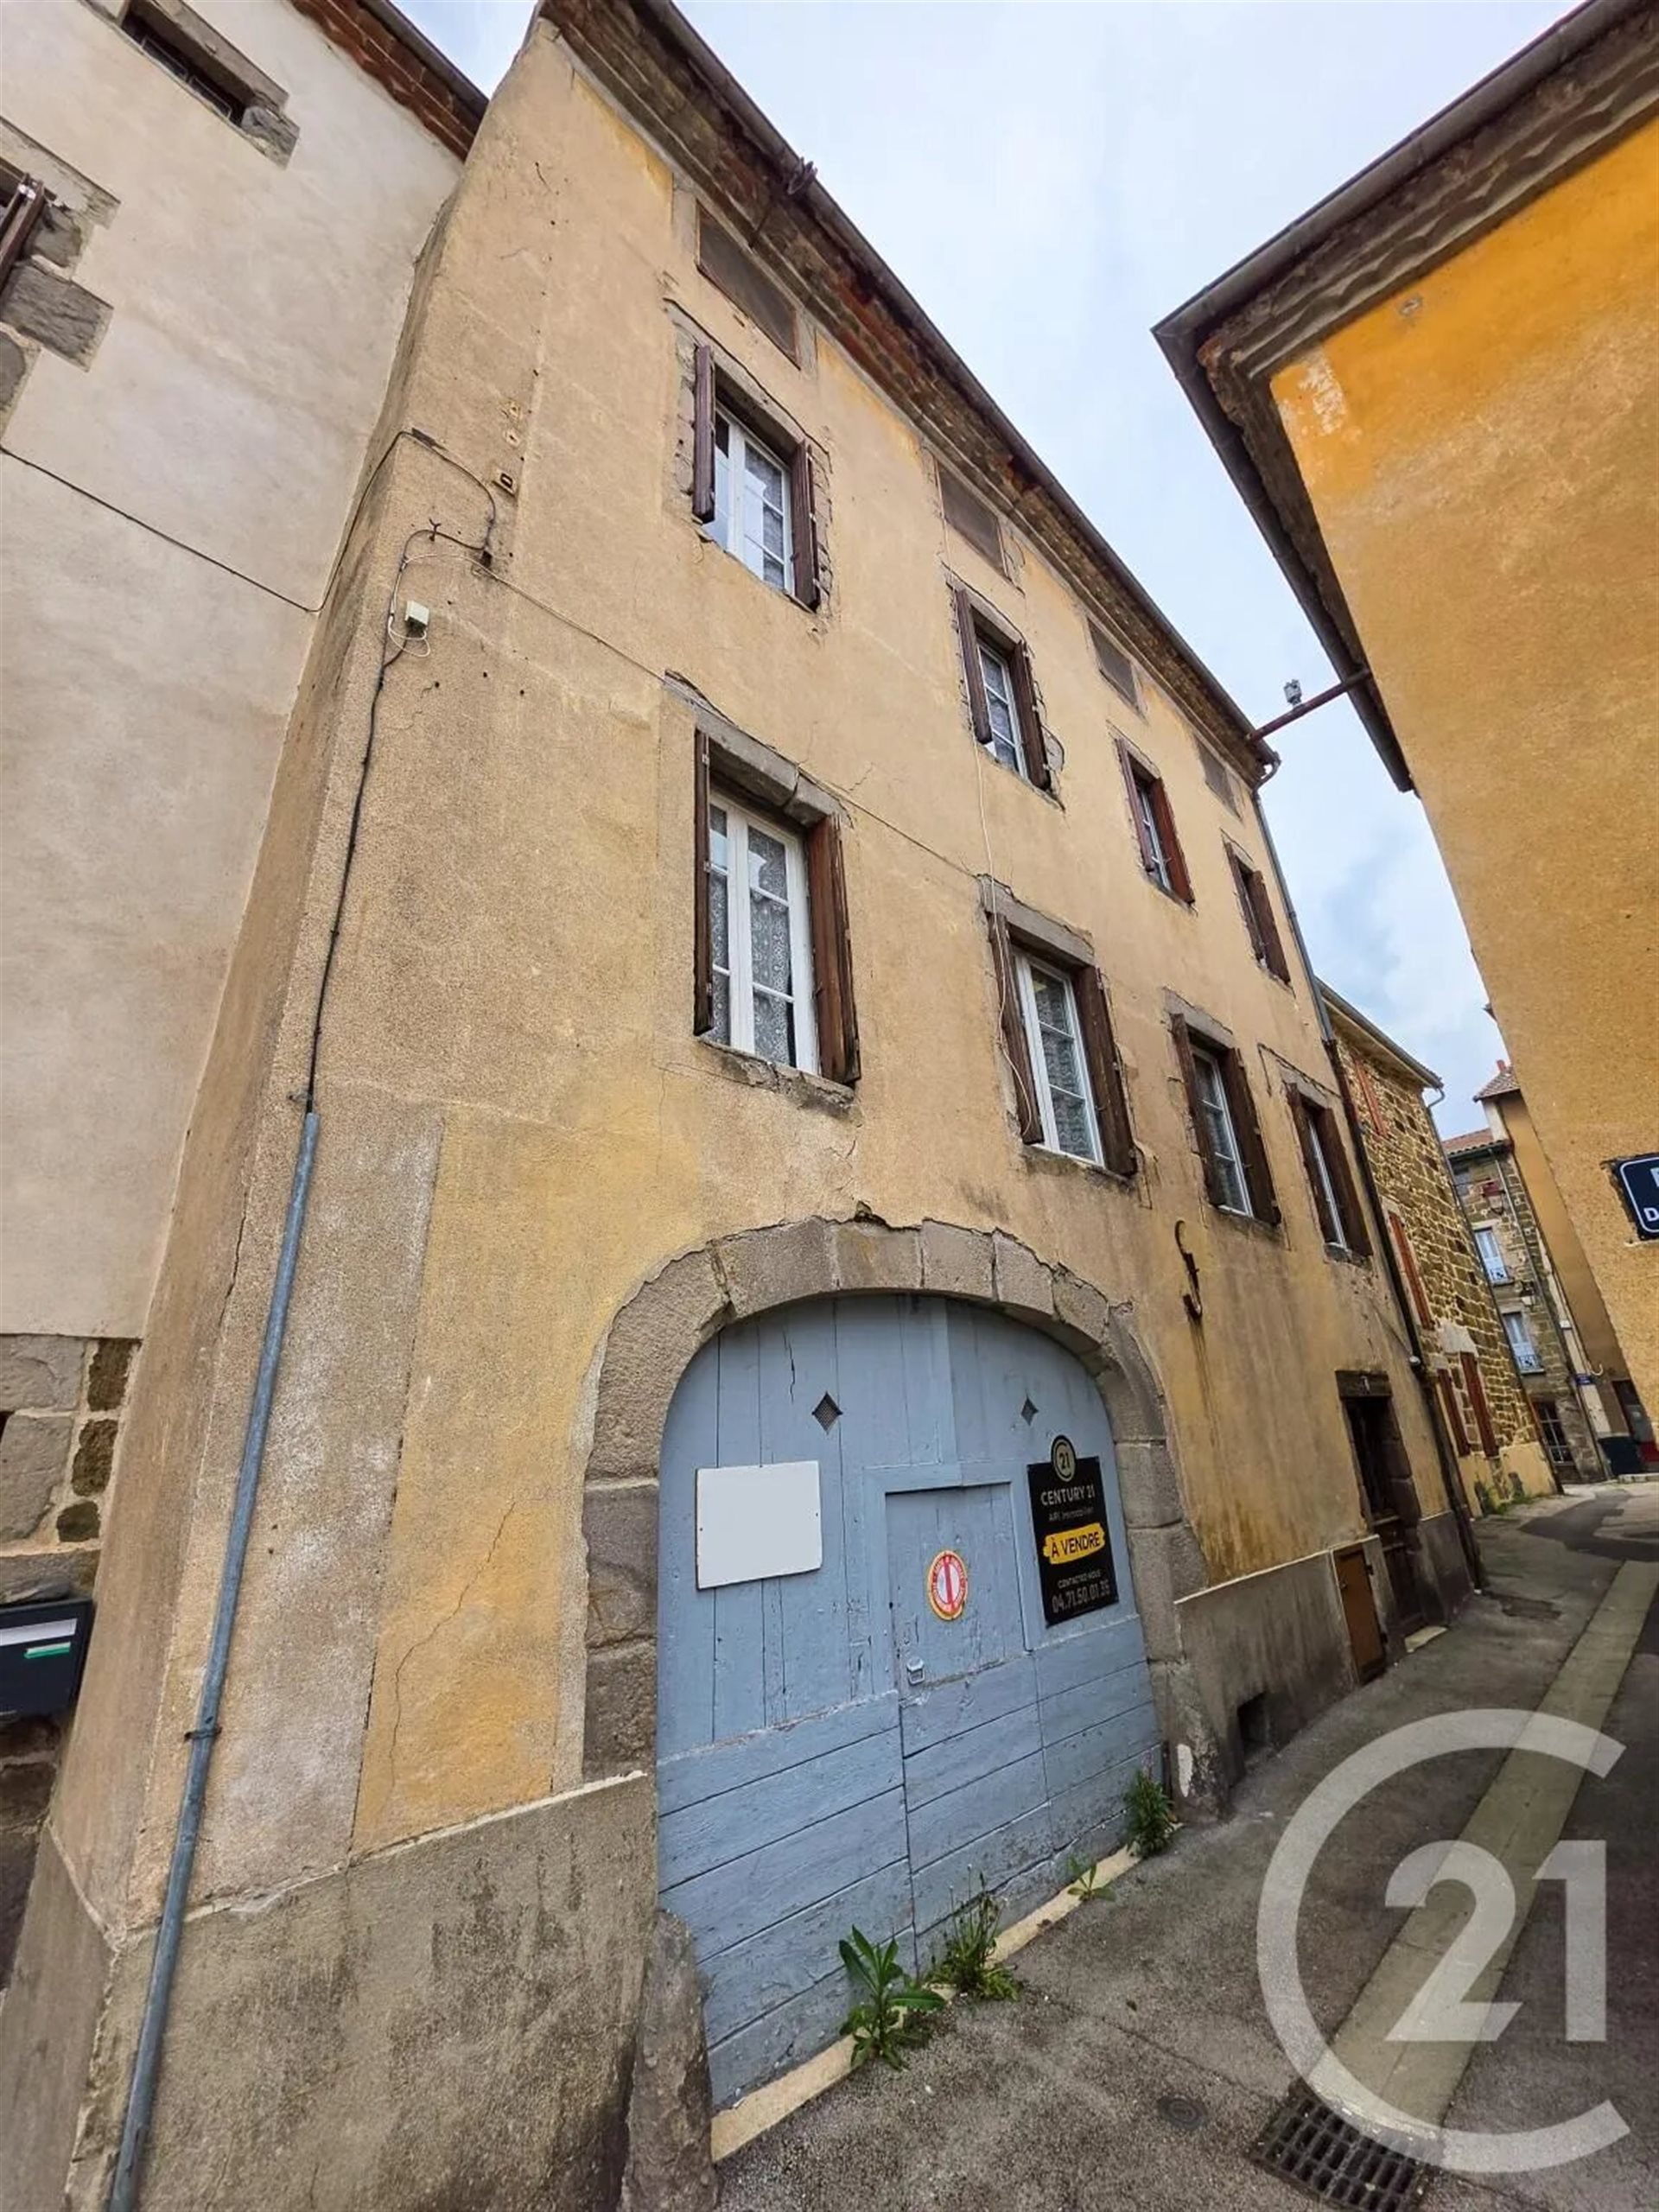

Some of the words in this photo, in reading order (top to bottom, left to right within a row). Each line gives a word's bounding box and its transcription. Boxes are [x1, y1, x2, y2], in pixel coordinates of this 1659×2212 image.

[1040, 1485, 1084, 1505] CENTURY
[1086, 1484, 1095, 1498] 21
[1051, 1536, 1060, 1558] À
[1061, 1531, 1100, 1555] VENDRE
